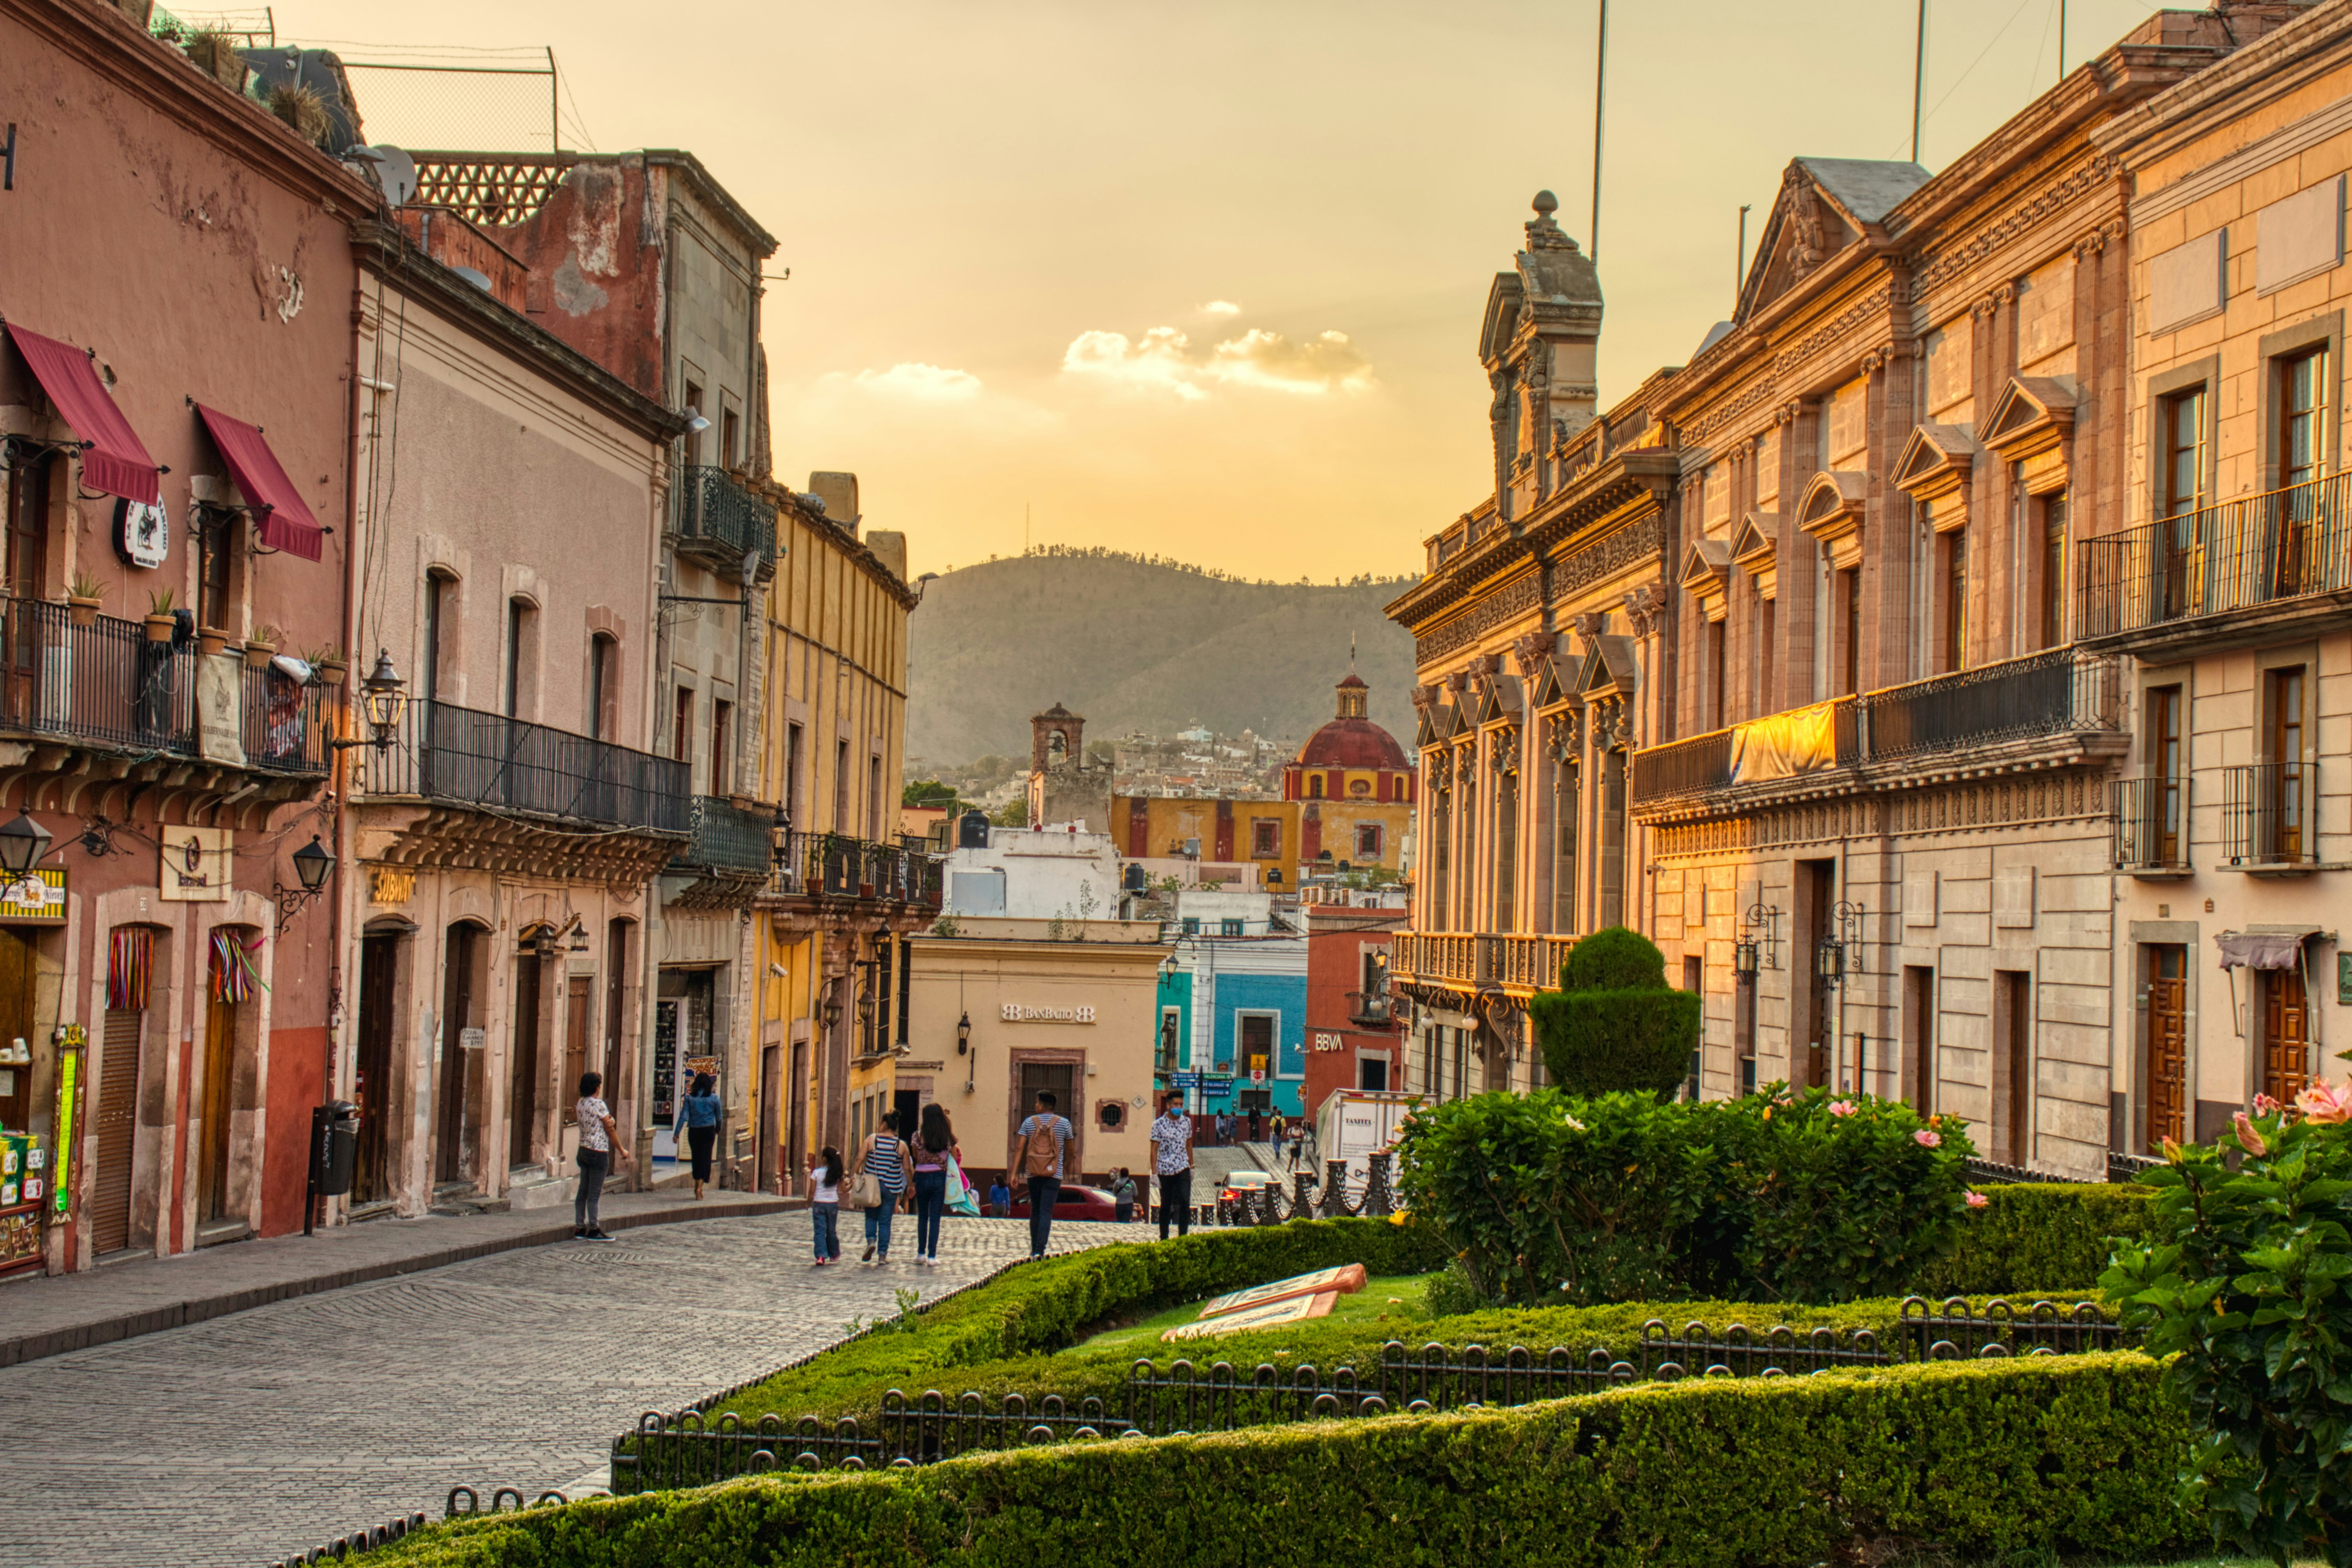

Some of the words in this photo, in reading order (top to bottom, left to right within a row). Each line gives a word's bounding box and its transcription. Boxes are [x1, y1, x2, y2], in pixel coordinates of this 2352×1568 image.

[158, 500, 168, 550] SANCHO
[43, 888, 63, 902] Nieves
[375, 873, 416, 902] SUBWAY
[1316, 1033, 1343, 1051] BBVA
